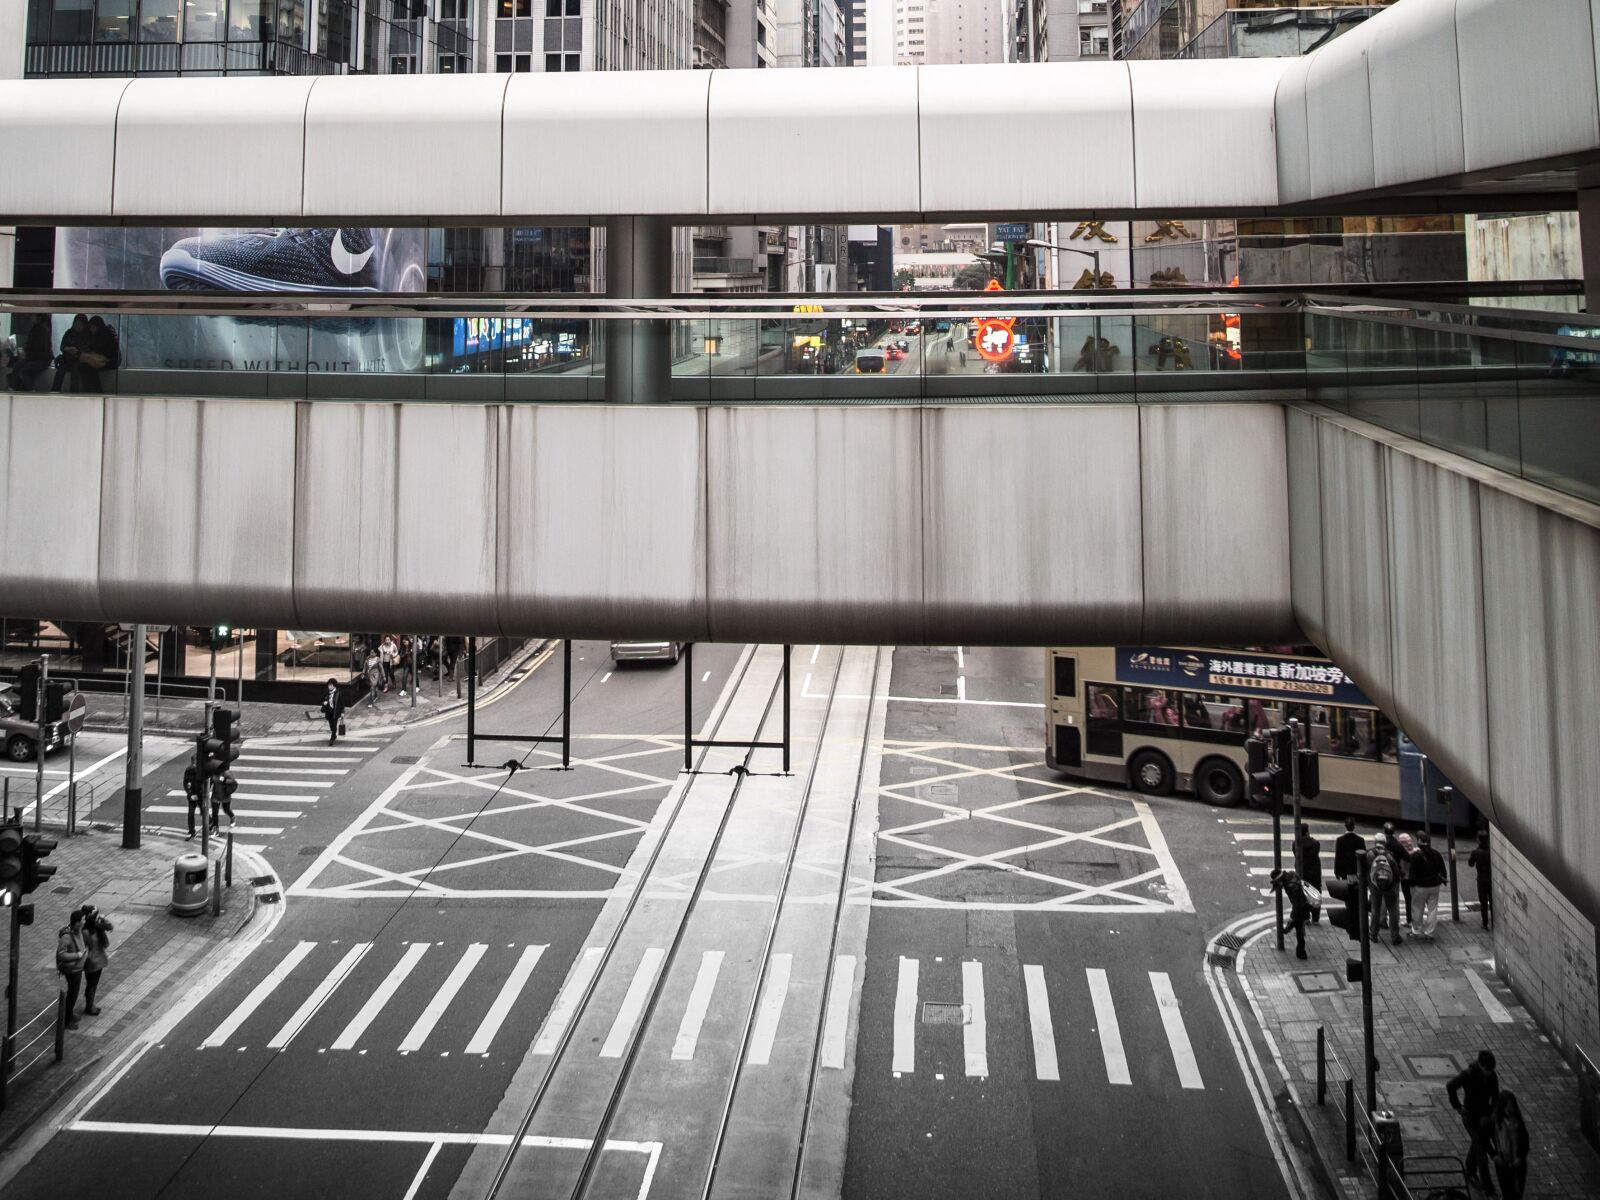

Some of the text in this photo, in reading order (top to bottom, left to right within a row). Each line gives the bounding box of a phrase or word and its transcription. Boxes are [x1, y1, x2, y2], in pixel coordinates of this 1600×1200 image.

[981, 326, 1009, 353] 押
[164, 358, 234, 370] SPEED
[244, 360, 351, 372] WITHOUT
